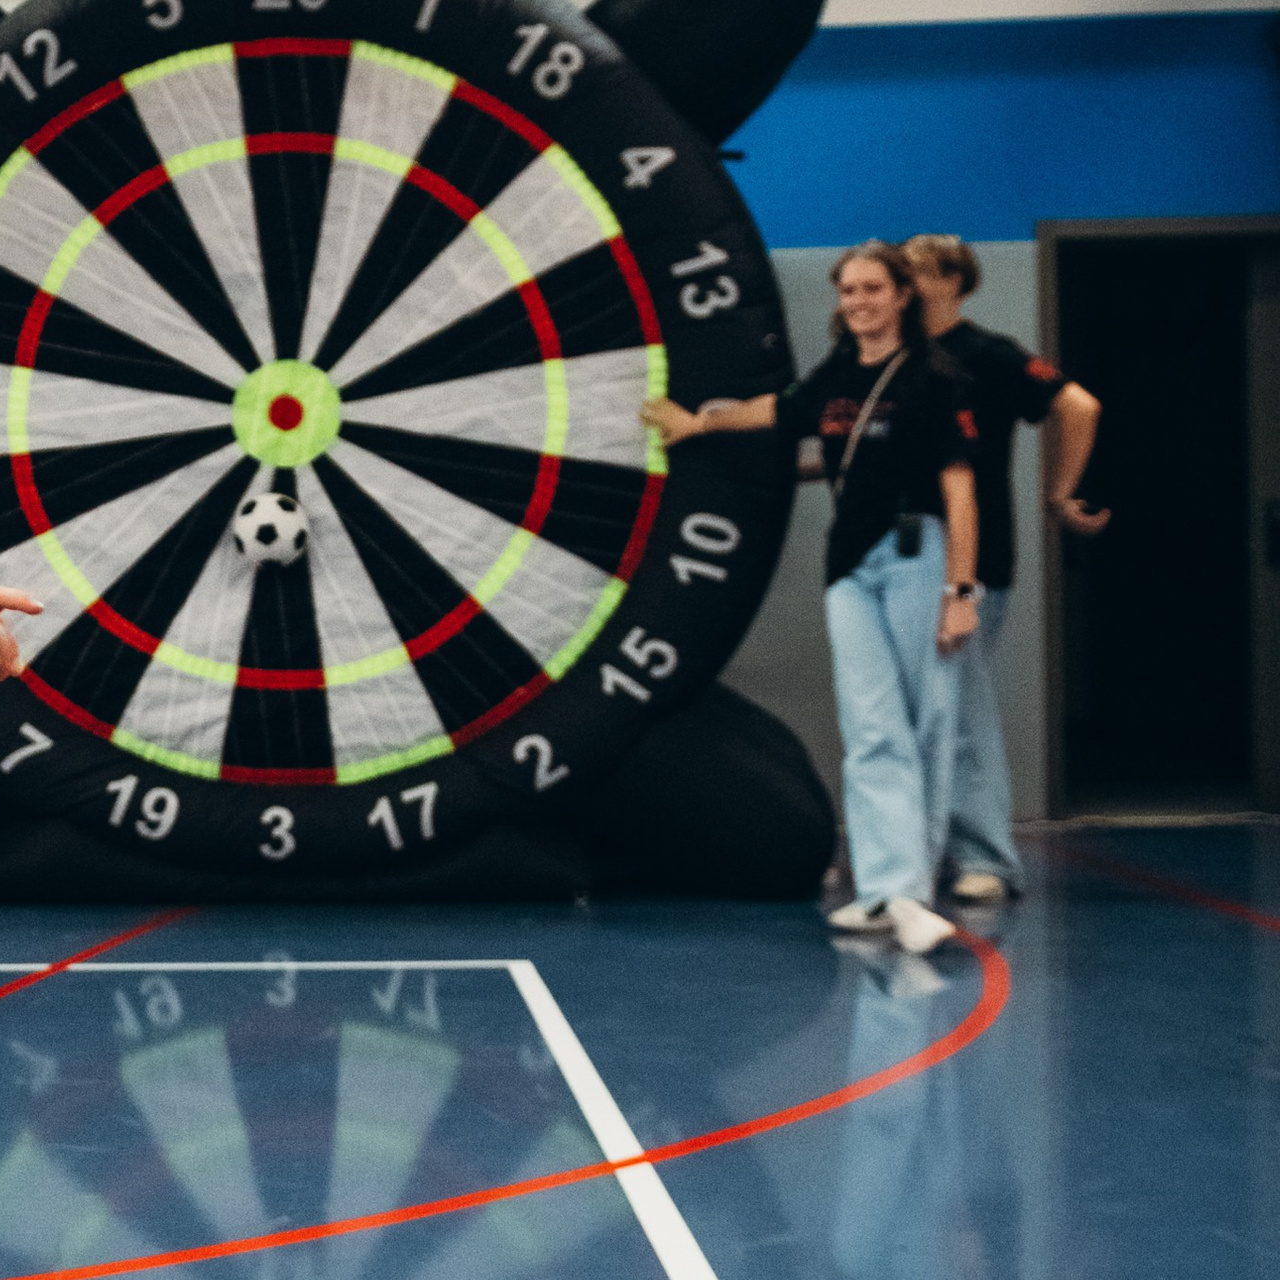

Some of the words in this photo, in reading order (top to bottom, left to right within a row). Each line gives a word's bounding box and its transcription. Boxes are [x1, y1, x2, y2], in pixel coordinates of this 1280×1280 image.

[507, 23, 584, 98] 18
[621, 146, 676, 188] 4
[671, 241, 740, 318] 13
[669, 512, 740, 584] 10
[600, 626, 678, 701] 15
[0, 722, 54, 772] 7
[512, 733, 569, 789] 2
[106, 774, 180, 839] 19
[260, 805, 296, 859] 3
[367, 781, 439, 849] 17
